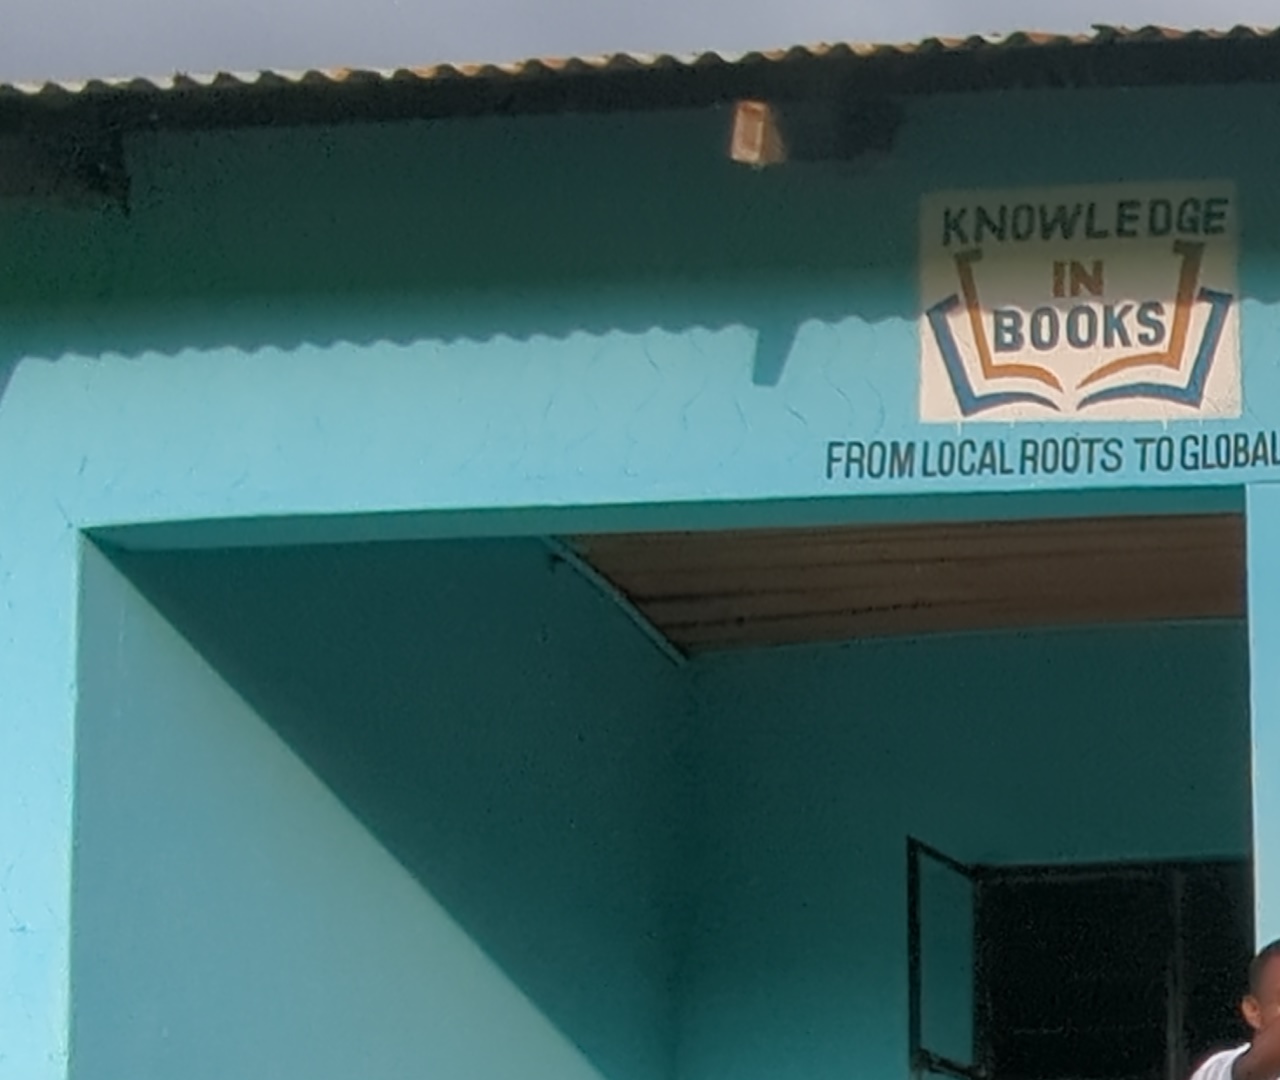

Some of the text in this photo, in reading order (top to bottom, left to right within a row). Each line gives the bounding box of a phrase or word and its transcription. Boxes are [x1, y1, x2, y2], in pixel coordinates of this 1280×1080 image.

[941, 197, 1230, 247] KNOWLEDGE
[1052, 260, 1105, 298] IN
[993, 302, 1167, 353] BOOKS
[826, 440, 915, 480] FROM
[921, 438, 1015, 477] LOCAL
[1018, 435, 1124, 475] ROOTS
[1133, 436, 1175, 472] TO
